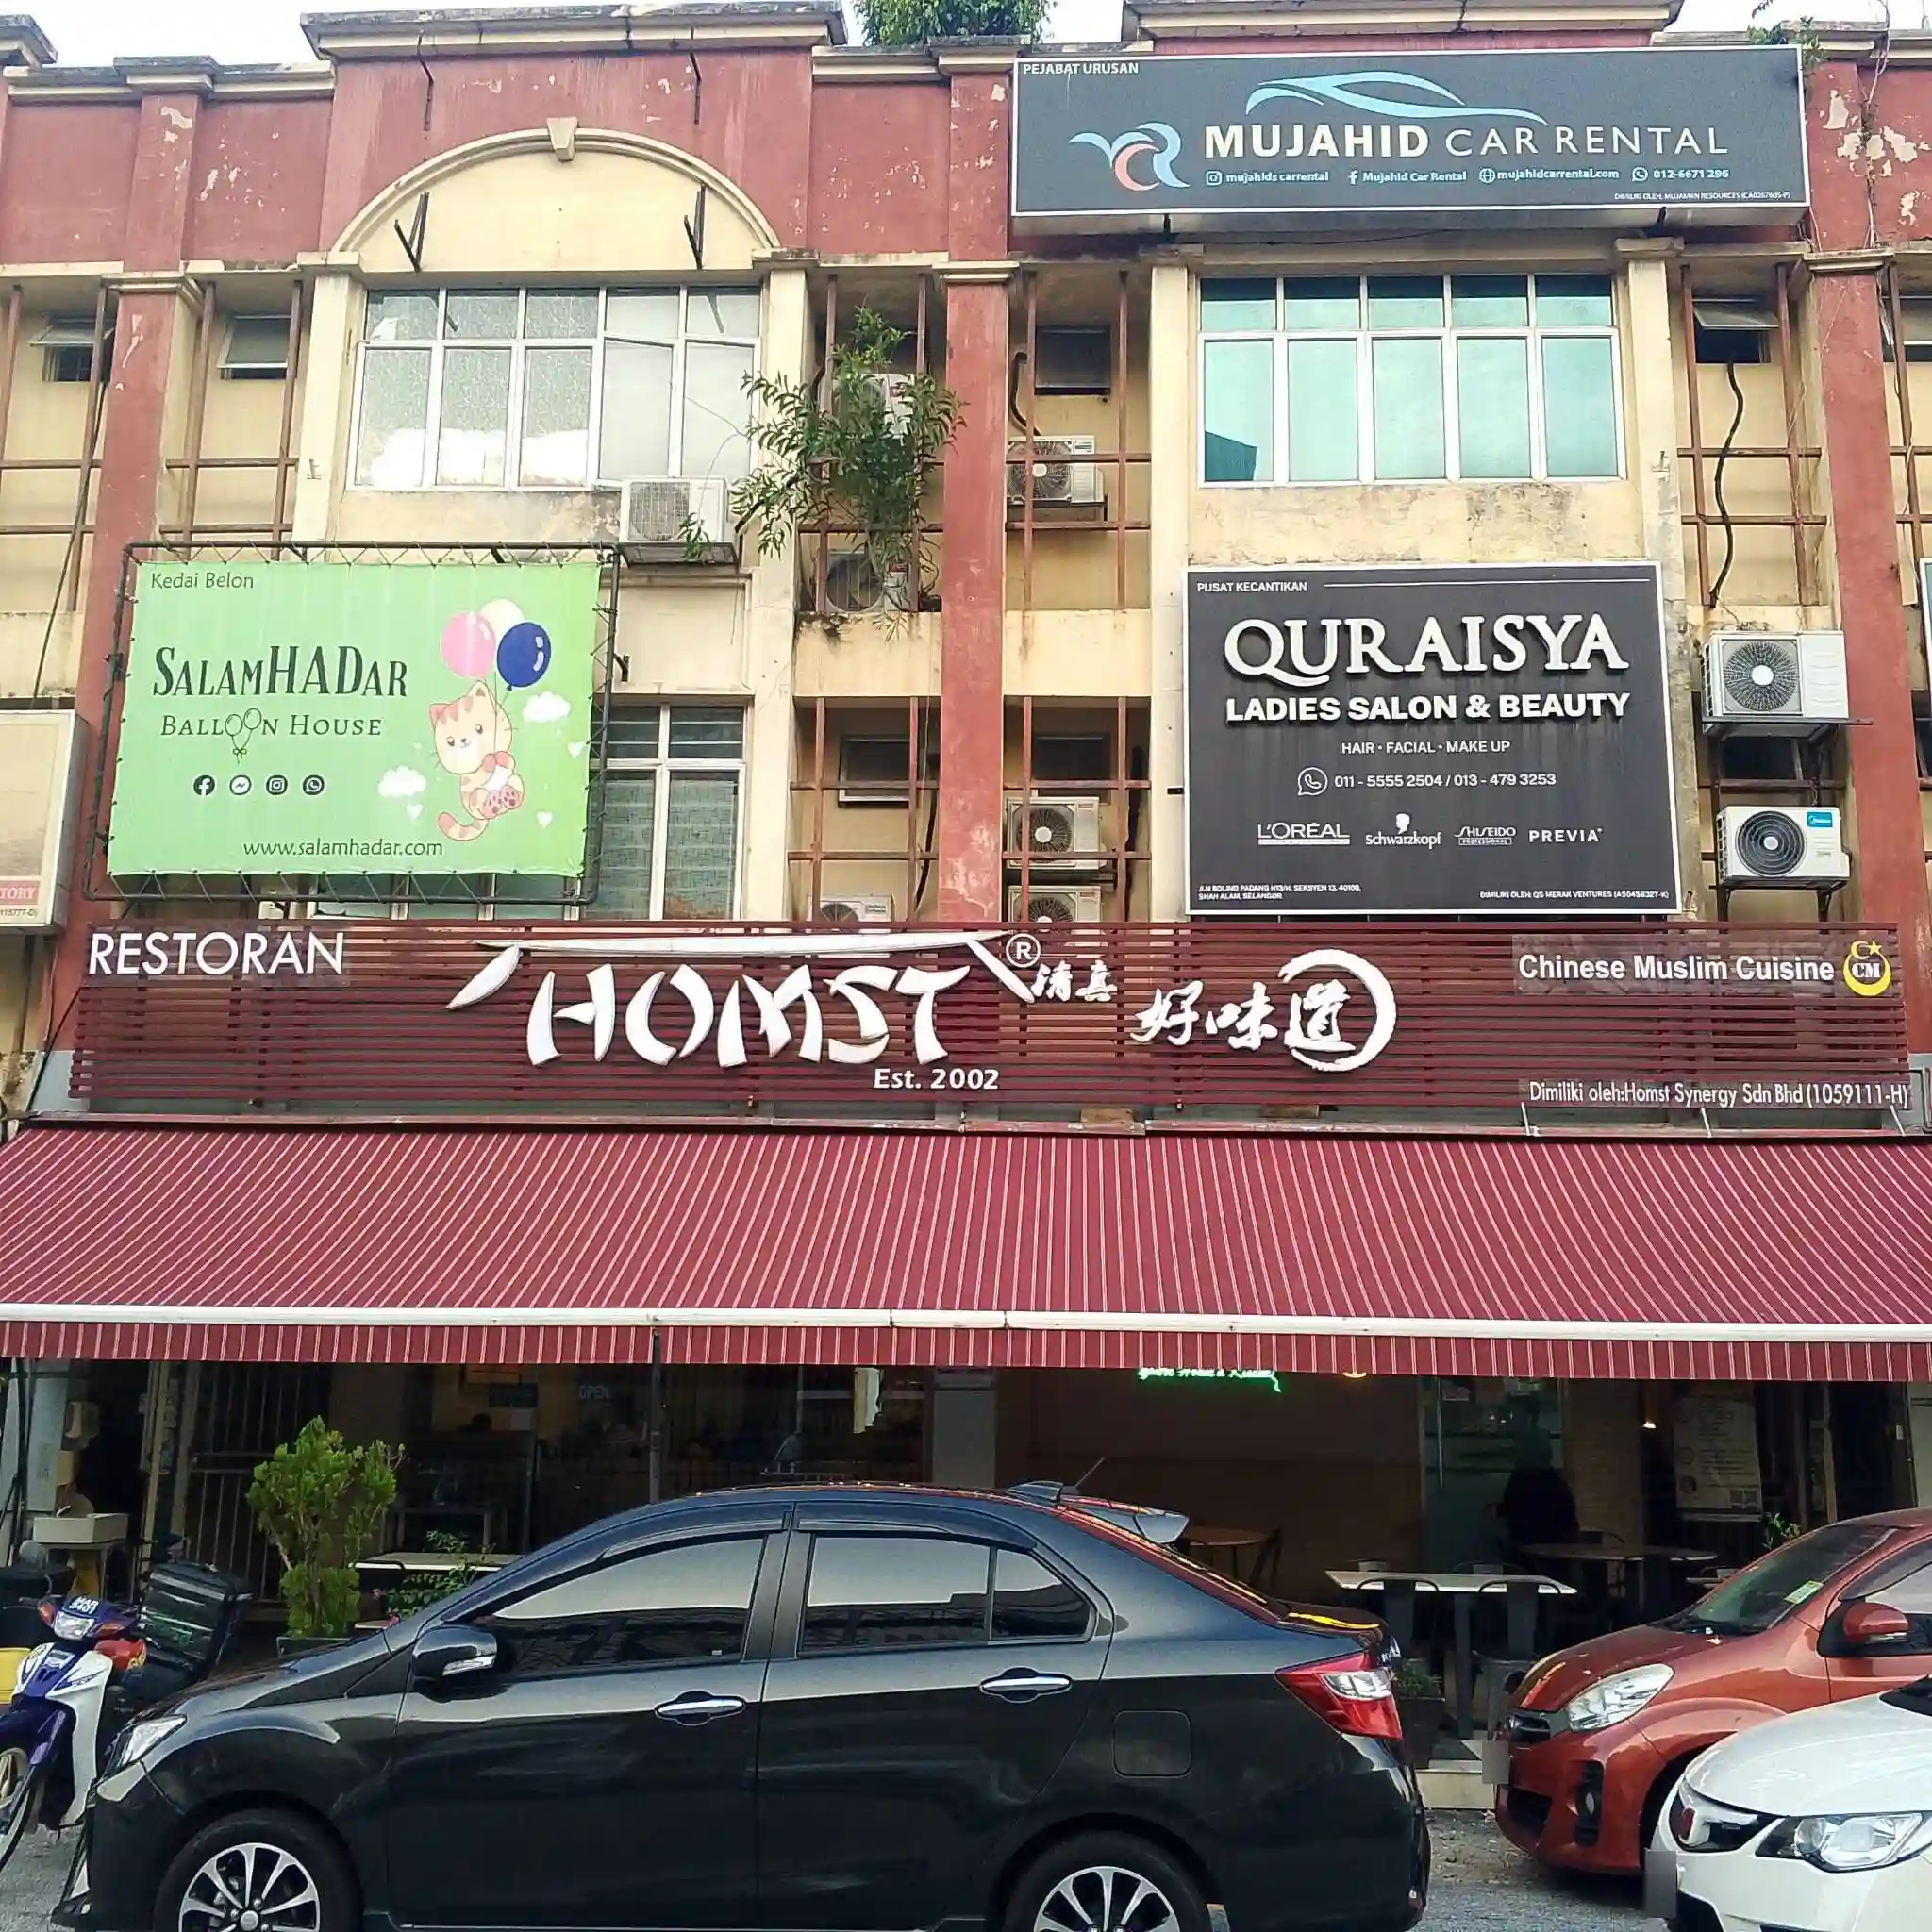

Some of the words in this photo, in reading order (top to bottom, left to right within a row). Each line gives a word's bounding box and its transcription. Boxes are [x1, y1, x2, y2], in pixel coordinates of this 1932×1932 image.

[1023, 63, 1080, 75] PEJABAT
[1083, 62, 1139, 74] URUSAN
[1205, 124, 1429, 158] MUJAHID
[1445, 128, 1540, 156] CAR
[1556, 126, 1728, 154] RENTAL
[1362, 171, 1408, 183] Mujahid
[1410, 173, 1429, 182] Car
[1430, 171, 1467, 182] Rental
[1497, 168, 1619, 181] mujahidcarrental.com
[1654, 169, 1705, 179] 012-6671
[1707, 169, 1729, 179] 296
[151, 572, 198, 589] Kedai
[205, 572, 254, 589] Belon
[1197, 581, 1233, 592] PUSAT
[1236, 580, 1307, 592] KECANTIKAN
[1224, 613, 1630, 687] QURAISYA
[1226, 695, 1341, 721] LADIES
[1347, 695, 1457, 720] SALON
[1465, 694, 1491, 719] &
[1498, 692, 1630, 718] BEAUTY
[290, 714, 383, 736] HOUSE
[1341, 741, 1375, 755] HAIR
[1386, 741, 1436, 754] FACIAL
[1446, 741, 1488, 753] MAKE
[1491, 741, 1511, 753] UP
[1334, 774, 1355, 787] 011
[1366, 774, 1404, 787] 5555
[1407, 774, 1443, 787] 2504
[1454, 774, 1478, 787] 013
[1489, 774, 1516, 786] 479
[1519, 773, 1557, 786] 3253
[1454, 825, 1516, 838] SHISEIDO
[242, 838, 444, 857] www.salamhadar.com
[89, 932, 343, 975] RESTORAN
[1518, 954, 1626, 980] Chinese
[1633, 955, 1728, 980] Muslim
[1735, 956, 1835, 981] Cuisine
[1851, 962, 1881, 978] CM
[526, 963, 971, 1068] HOMST
[1129, 979, 1357, 1052] 好味道
[873, 1068, 922, 1090] Est.
[930, 1068, 999, 1090] 2002
[1529, 1081, 1584, 1102] Dimiliki
[1674, 1083, 1737, 1108] Synergy
[1742, 1083, 1772, 1103] Sdn
[1774, 1083, 1804, 1103] Bhd
[1807, 1083, 1908, 1108] (1059111-H)
